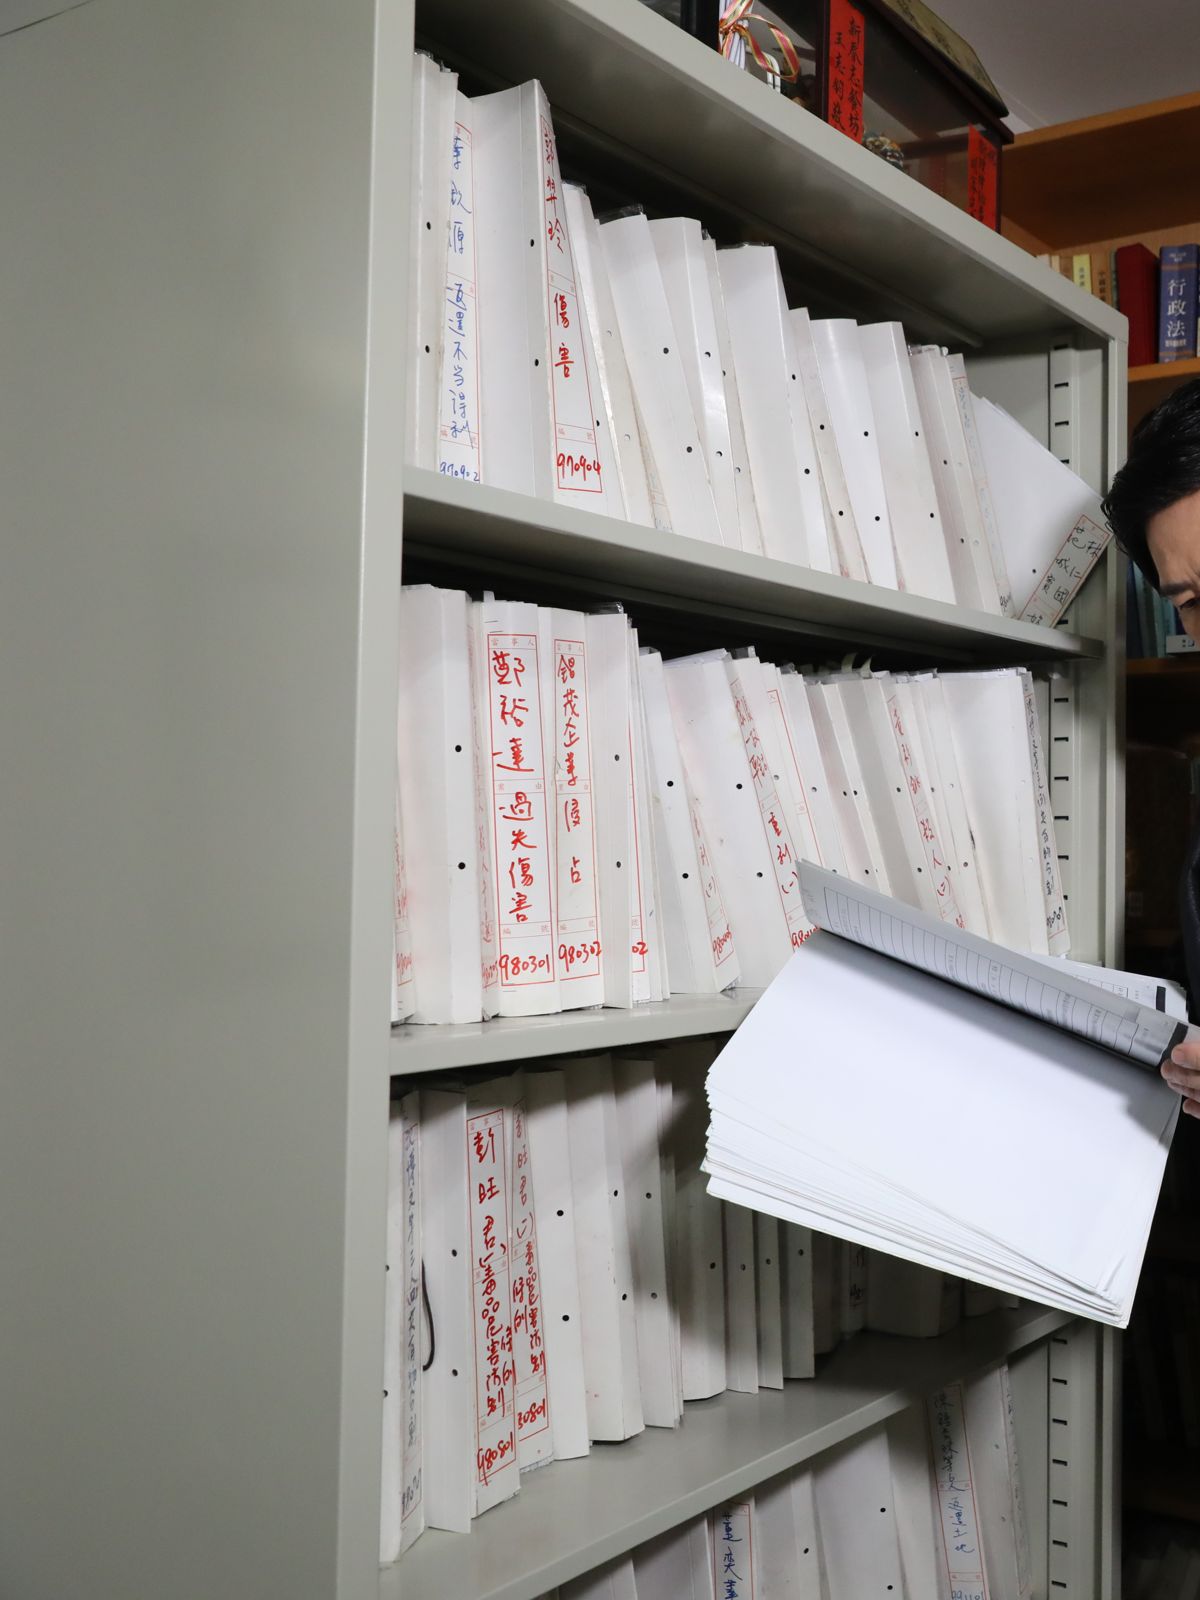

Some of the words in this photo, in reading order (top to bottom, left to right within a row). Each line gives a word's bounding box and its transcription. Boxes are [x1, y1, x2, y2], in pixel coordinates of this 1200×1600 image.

[1167, 278, 1187, 338] 行政法
[556, 452, 602, 482] 970904
[498, 792, 537, 923] 過失傷害
[498, 954, 551, 983] 980301
[558, 942, 602, 971] 980302
